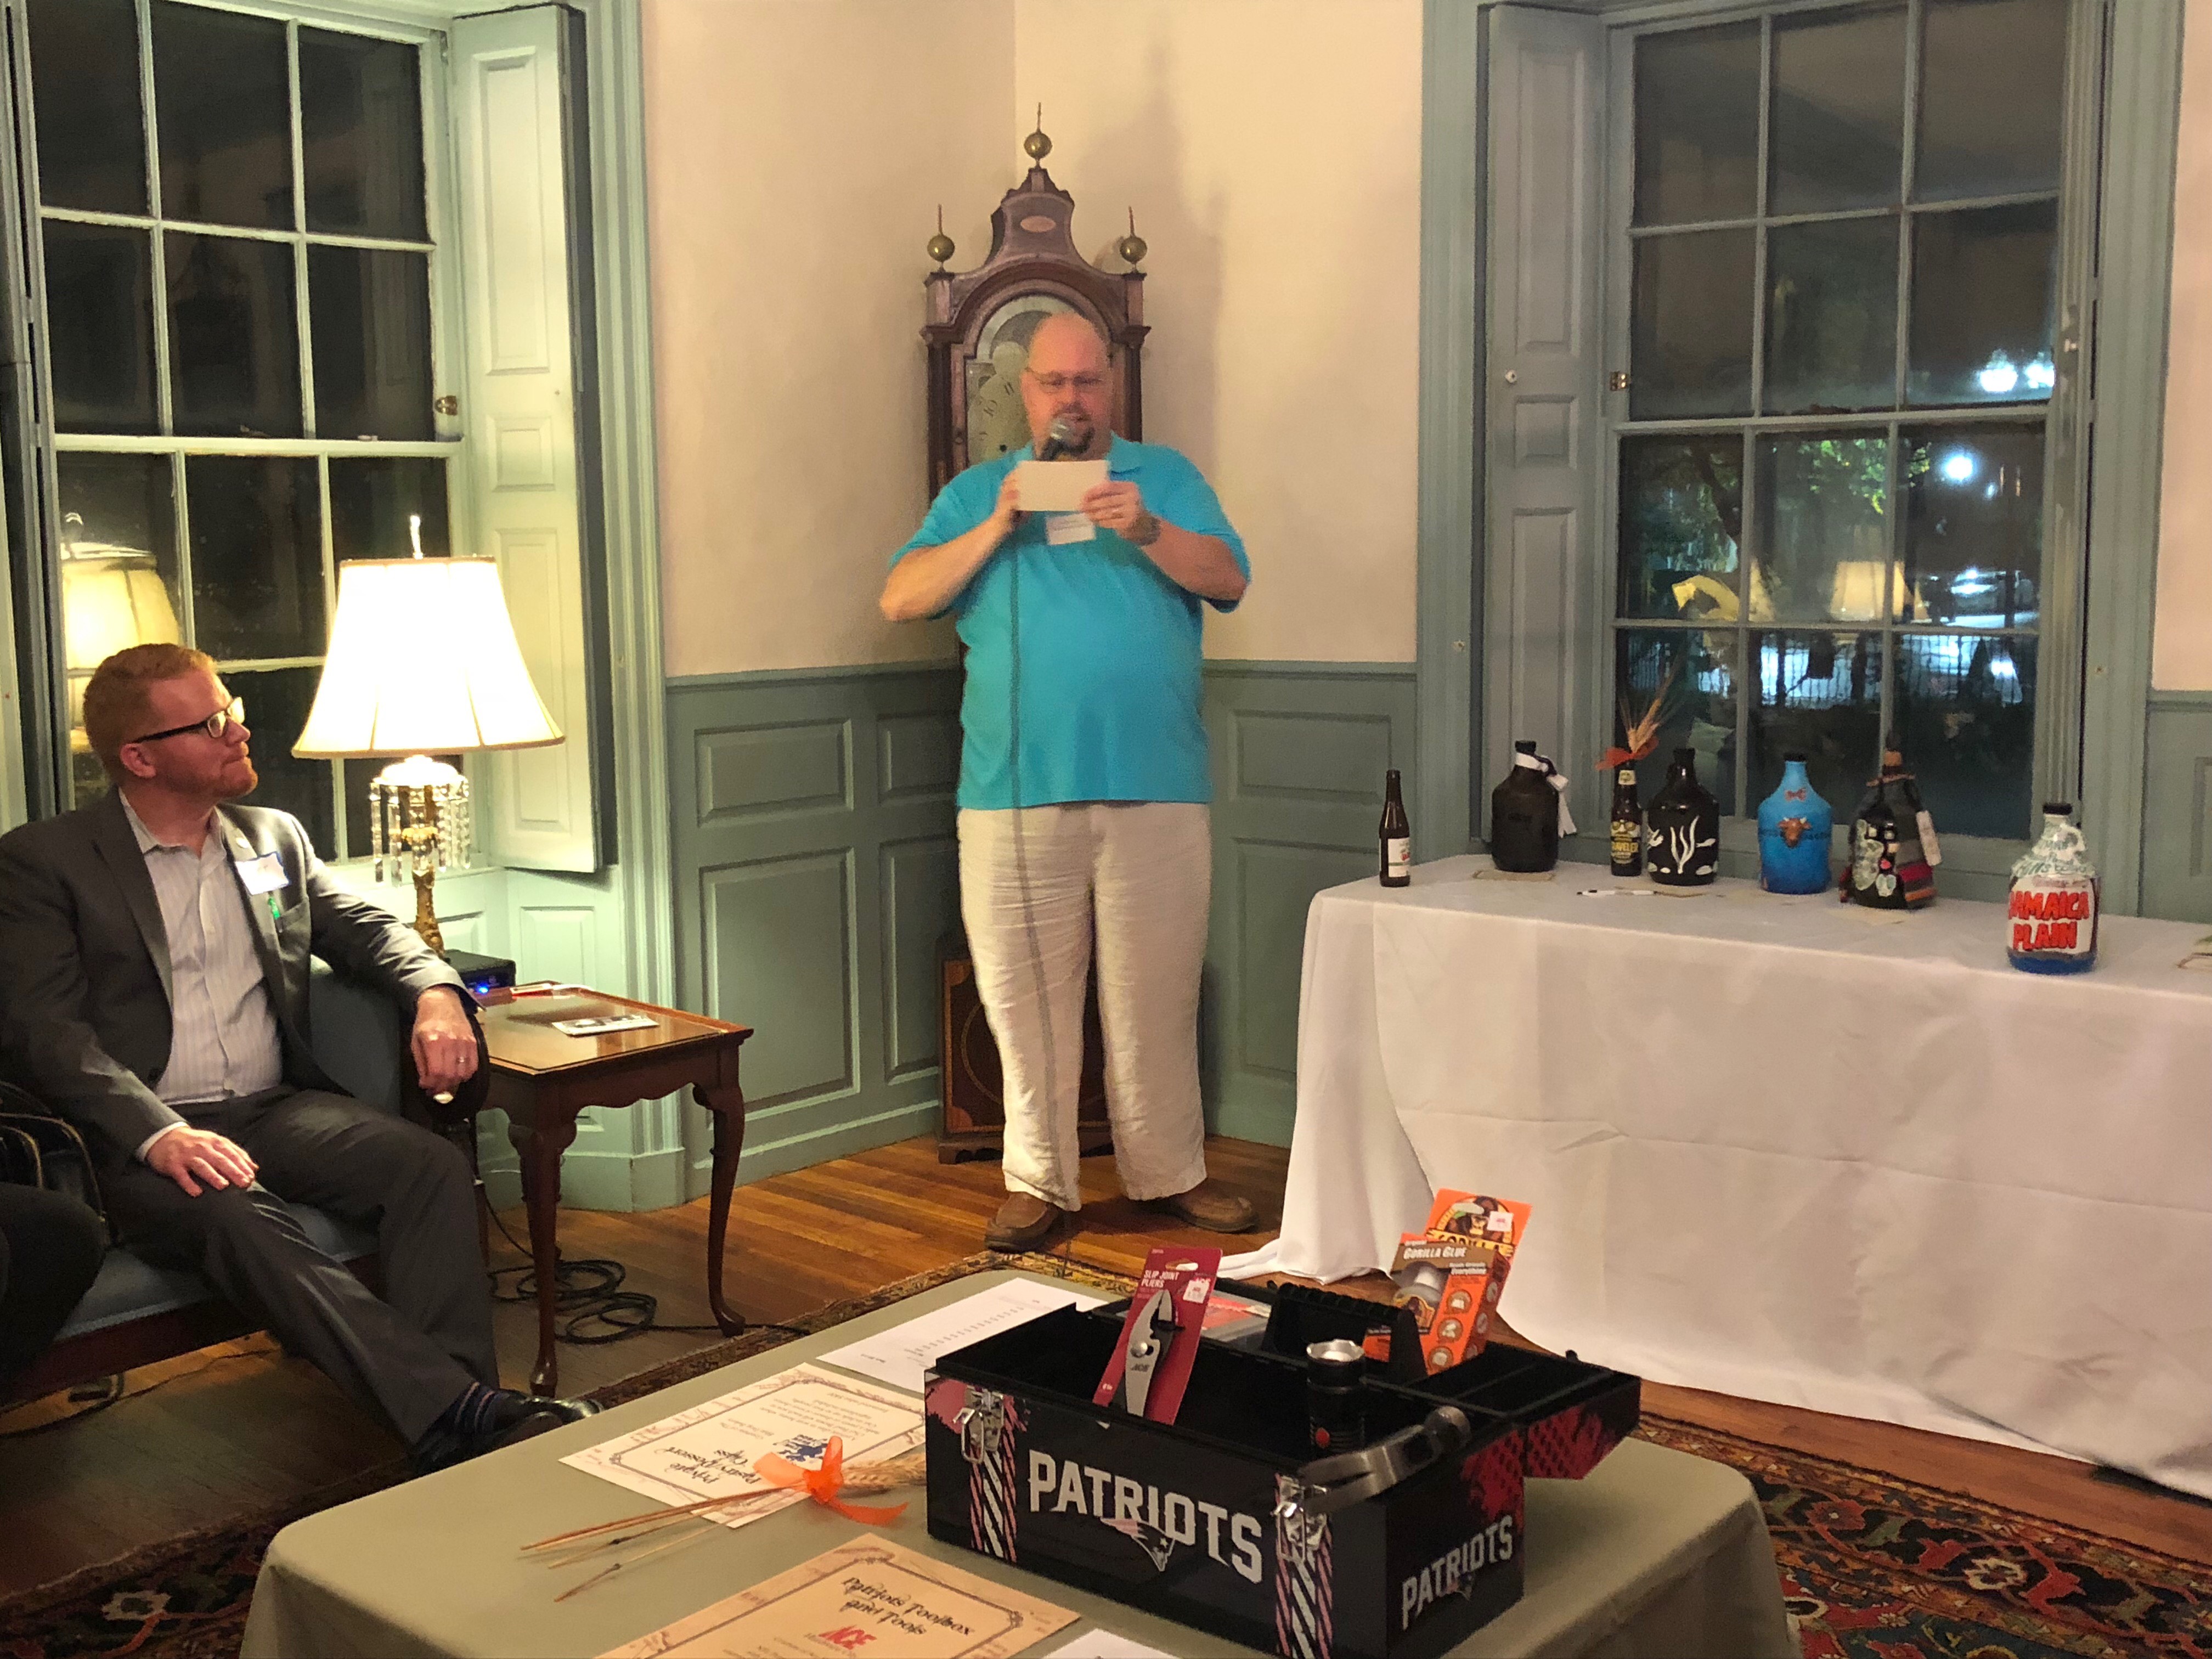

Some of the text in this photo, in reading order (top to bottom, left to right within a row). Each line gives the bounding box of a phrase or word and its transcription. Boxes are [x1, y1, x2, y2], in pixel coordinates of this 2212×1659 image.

[1611, 842, 1639, 853] RAVELER
[2008, 890, 2090, 921] JAMAICA
[2013, 921, 2078, 951] PLAIN
[1403, 1246, 1467, 1260] GORILLA GLUE
[1141, 1278, 1164, 1288] PLIERS
[1144, 1269, 1180, 1280] SLIP JOINT
[1028, 1449, 1262, 1584] PATRIOTS
[1402, 1514, 1513, 1630] PATRIOTS
[842, 1577, 975, 1636] Patriots Toolbox
[877, 1610, 927, 1635] Tools
